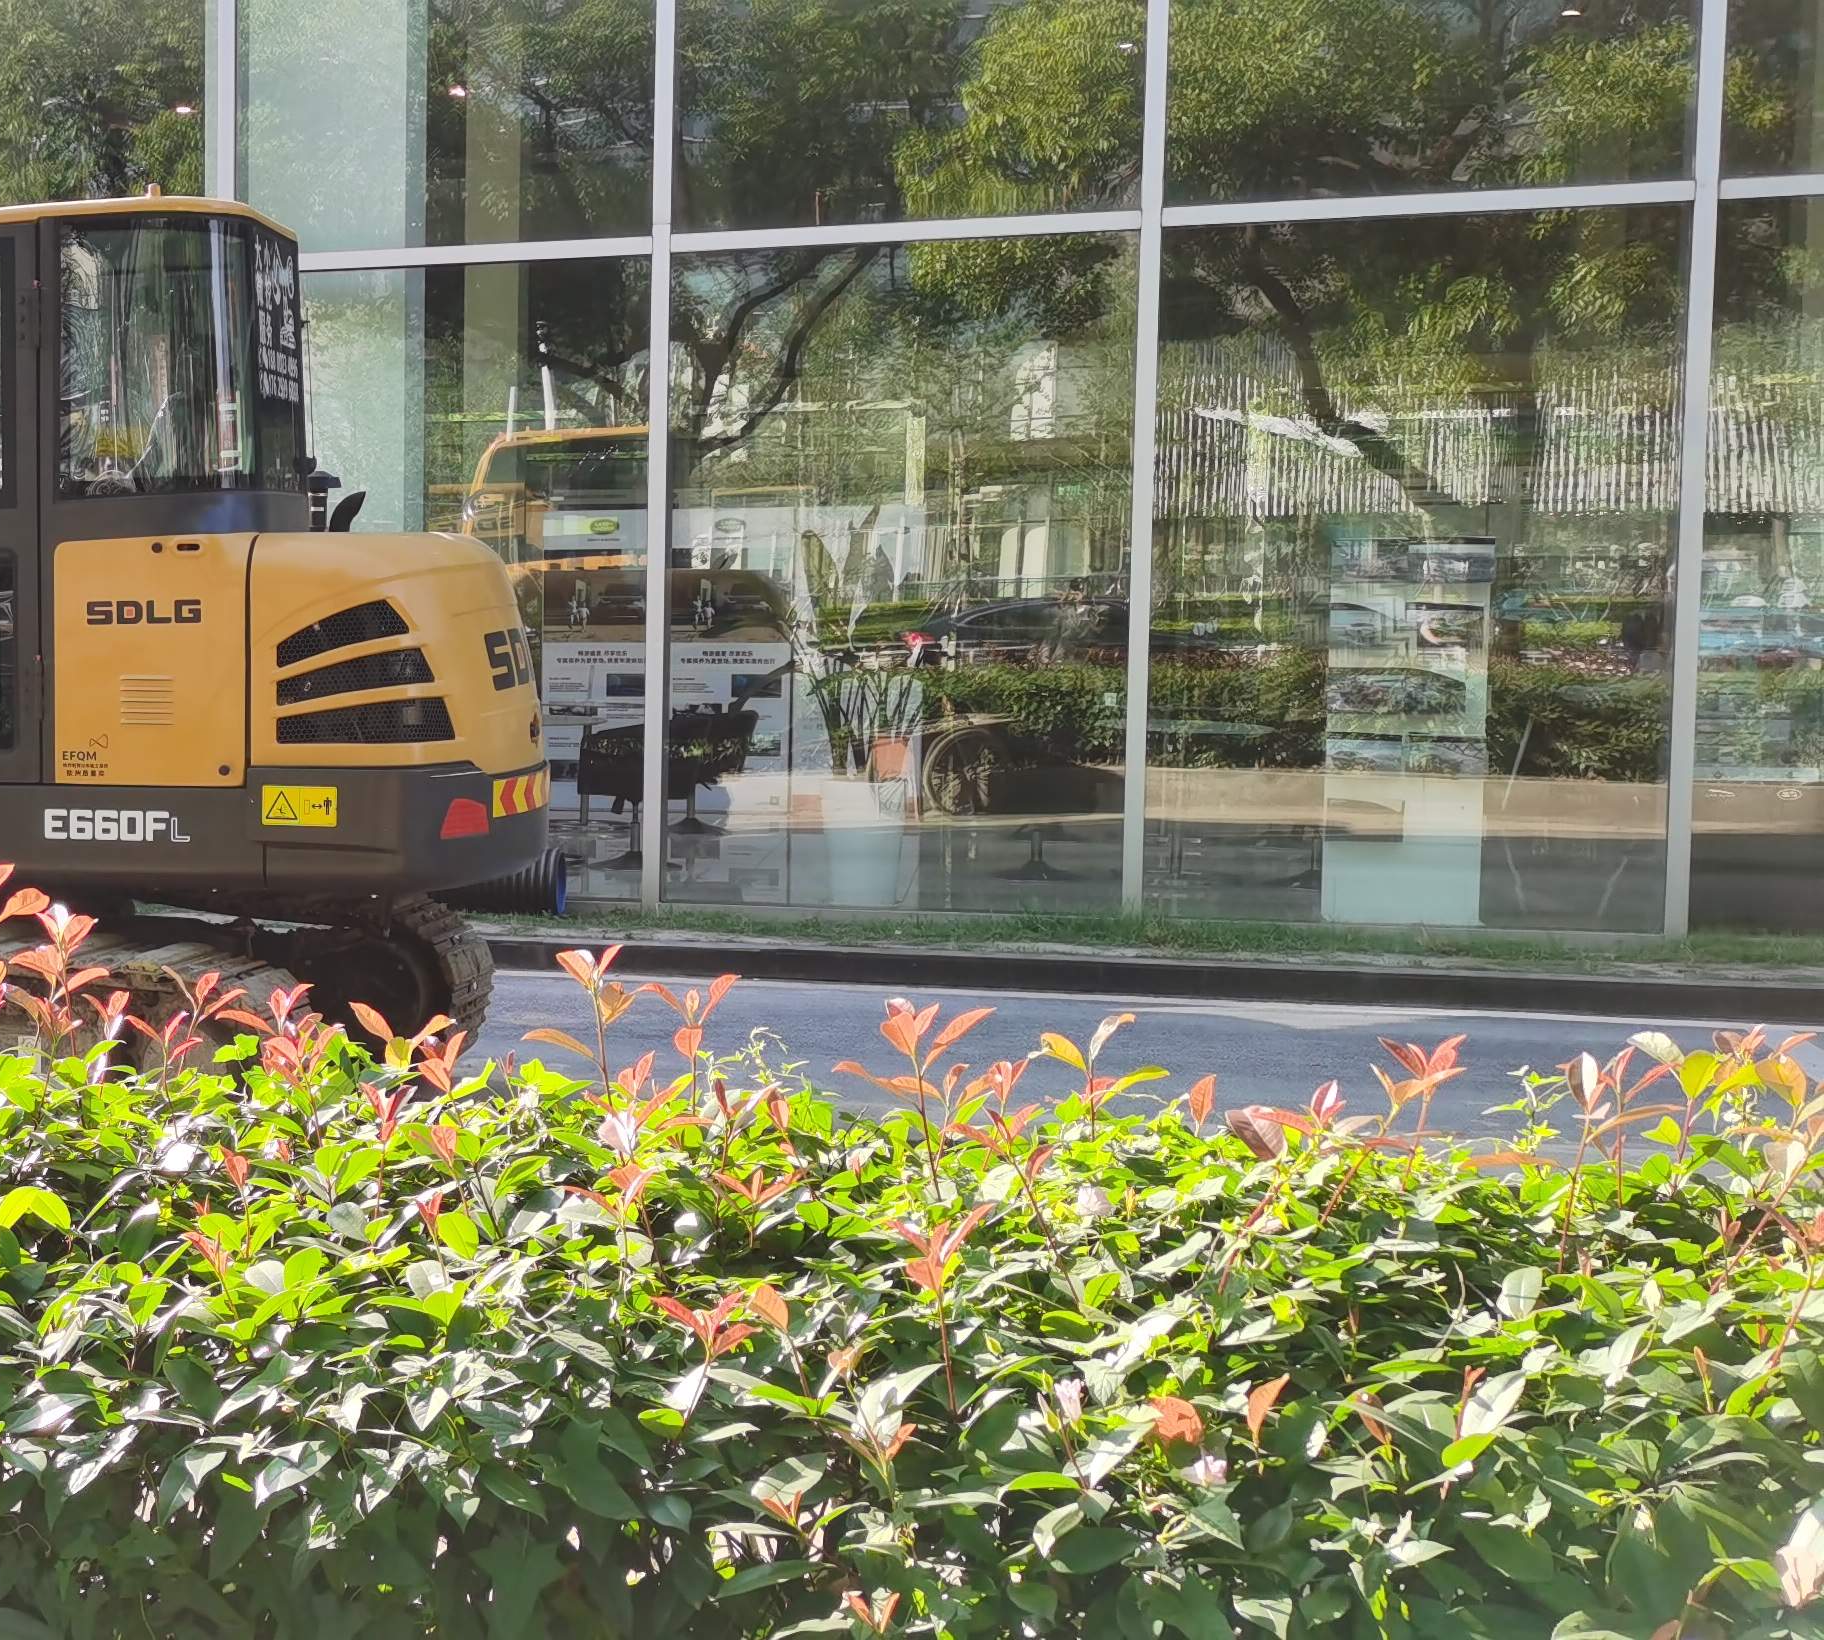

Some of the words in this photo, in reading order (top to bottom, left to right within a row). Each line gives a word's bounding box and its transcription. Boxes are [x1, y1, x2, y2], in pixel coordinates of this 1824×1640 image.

[86, 599, 202, 625] SDLG
[484, 628, 533, 691] SD
[62, 751, 97, 761] EFQM
